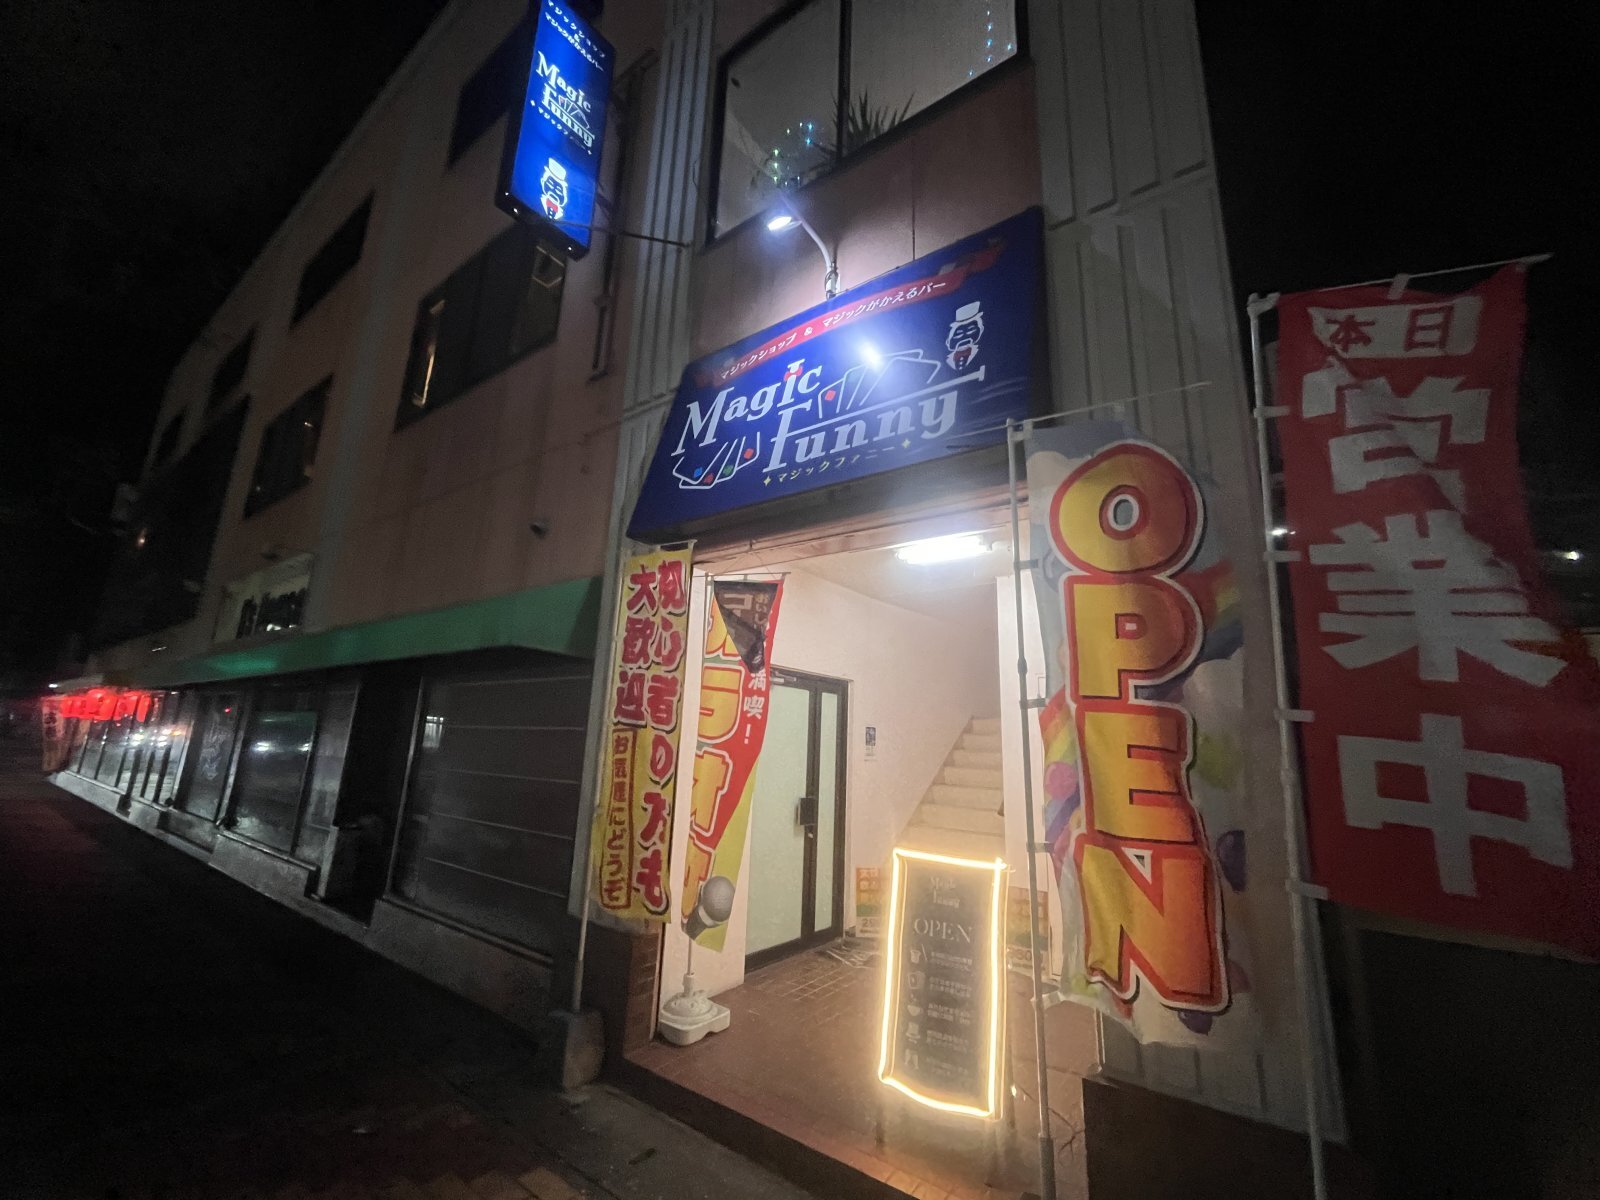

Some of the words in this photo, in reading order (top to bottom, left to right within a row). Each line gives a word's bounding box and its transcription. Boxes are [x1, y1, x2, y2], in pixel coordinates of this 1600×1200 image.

[536, 50, 591, 112] Magic
[541, 82, 595, 148] Funny
[720, 332, 798, 380] マジックショップ
[803, 326, 814, 336] &
[822, 281, 947, 328] マジックがかえるバー
[1327, 303, 1455, 355] 本日
[671, 358, 822, 458] Magic
[763, 365, 986, 473] Funny
[777, 446, 896, 483] マジックファニー
[613, 563, 658, 724] 大歓迎
[1301, 358, 1574, 899] 営業中
[1049, 440, 1231, 1013] OPEN
[913, 918, 973, 944] OPEN
